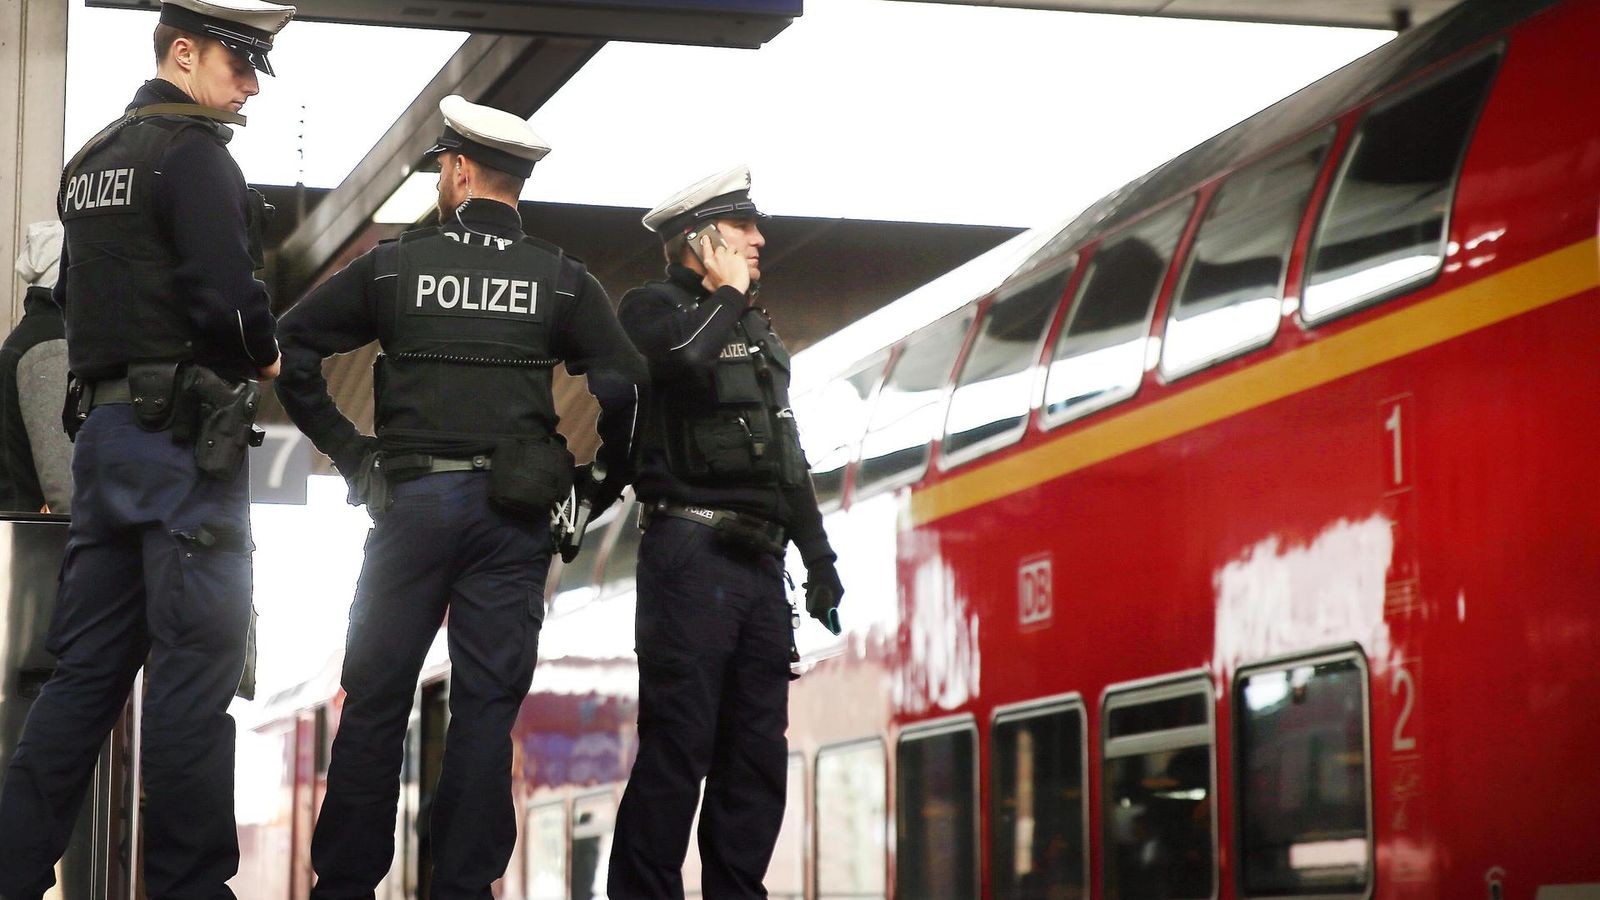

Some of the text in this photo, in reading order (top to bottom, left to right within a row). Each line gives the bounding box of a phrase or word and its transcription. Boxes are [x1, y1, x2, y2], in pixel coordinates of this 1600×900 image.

[65, 168, 135, 213] POLIZEI
[416, 274, 538, 315] POLIZEI
[264, 425, 303, 488] 7
[1385, 404, 1403, 485] 1
[1021, 565, 1050, 619] DB
[1391, 669, 1416, 750] 2
